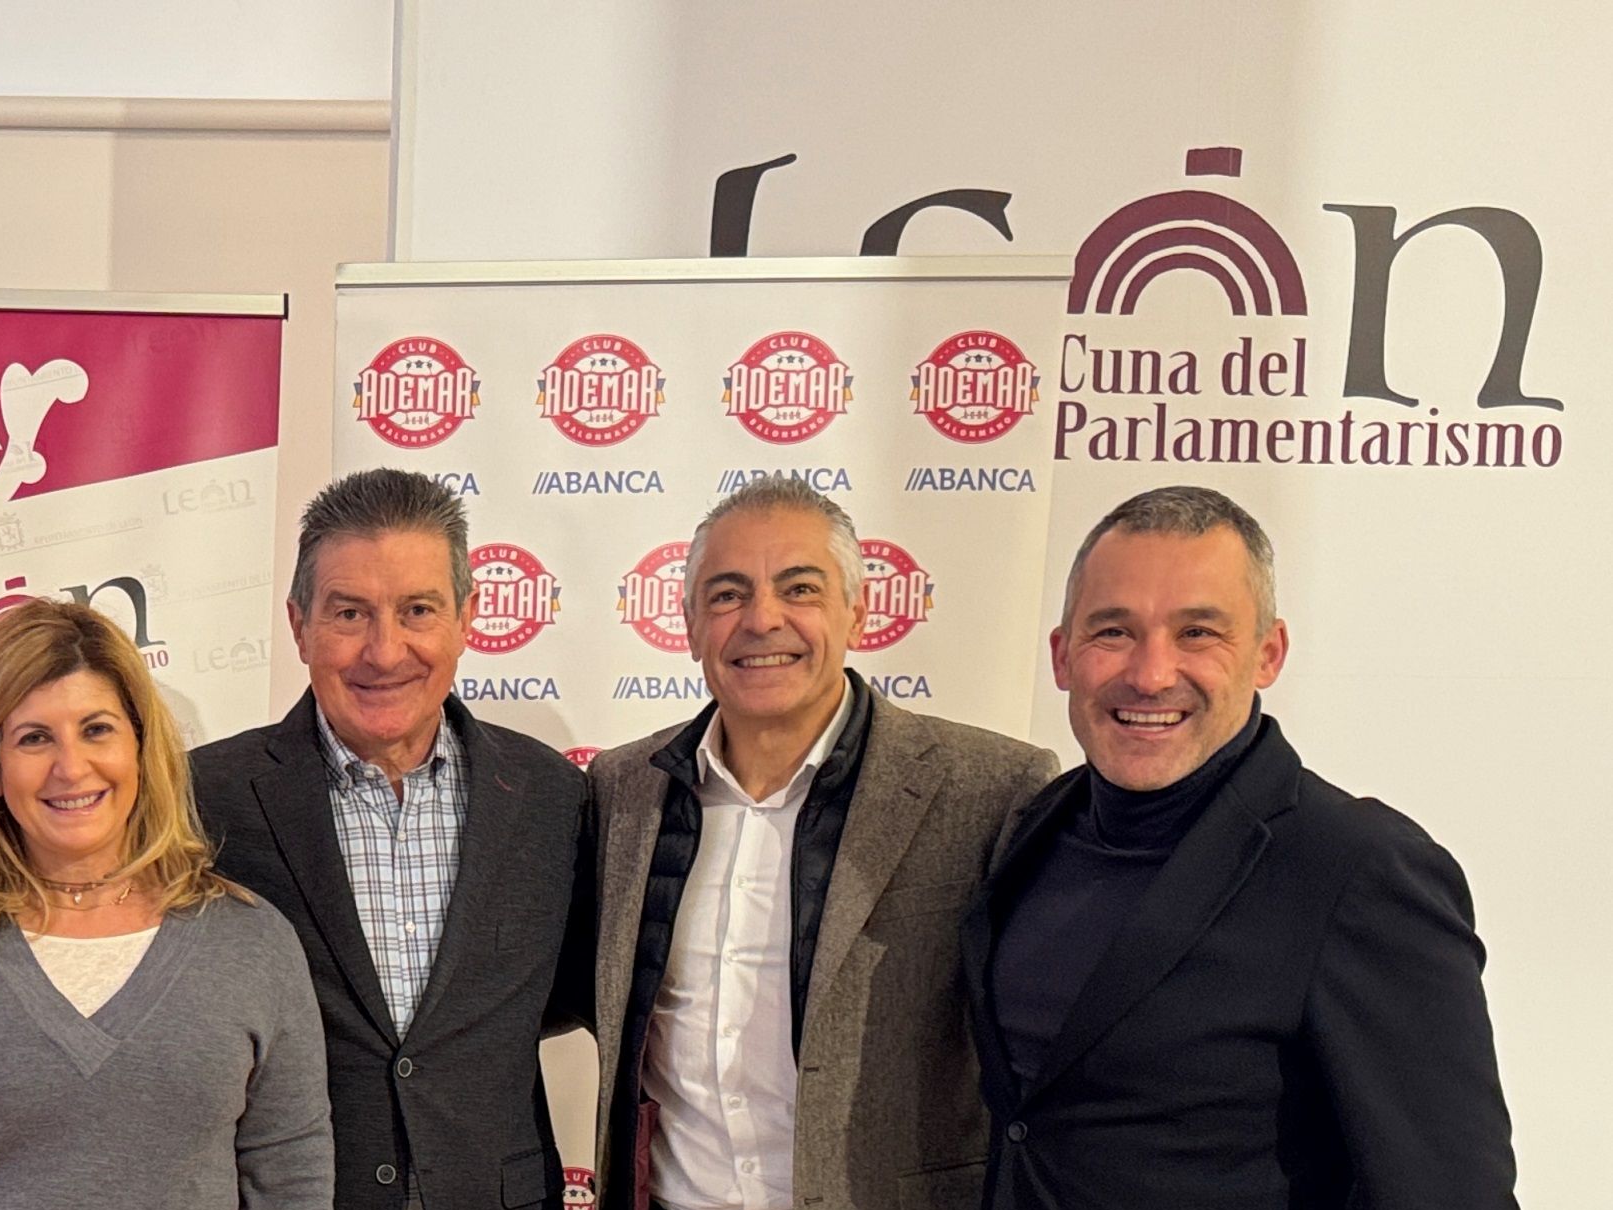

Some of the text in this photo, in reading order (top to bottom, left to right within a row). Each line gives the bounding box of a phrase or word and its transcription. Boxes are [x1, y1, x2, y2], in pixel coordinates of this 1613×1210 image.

[398, 342, 437, 354] CLUB
[583, 340, 622, 351] CLUB
[769, 336, 809, 349] CLUB
[957, 336, 997, 348] CLUB
[1061, 334, 1308, 398] Cuna del
[359, 366, 475, 419] ADEMAR
[543, 365, 660, 417] ADEMAR
[728, 362, 847, 415] ADEMAR
[917, 361, 1034, 414] ADEMAR
[1053, 403, 1564, 470] Parlamentarismo
[479, 549, 518, 561] CLUB
[861, 546, 890, 557] LUB
[478, 573, 554, 624] EMAR
[624, 572, 684, 623] ADE
[466, 627, 533, 648] ALONMANO
